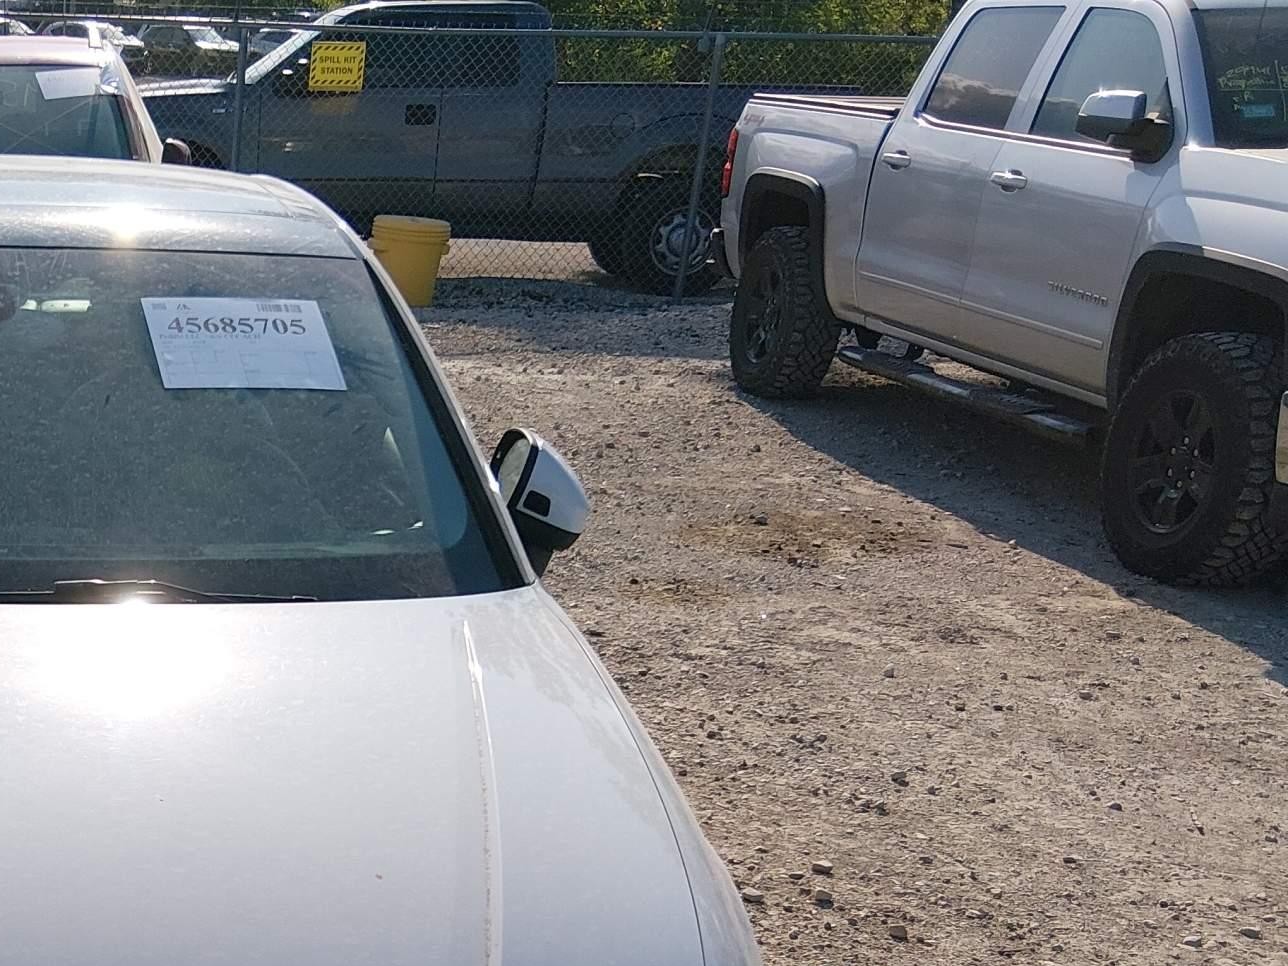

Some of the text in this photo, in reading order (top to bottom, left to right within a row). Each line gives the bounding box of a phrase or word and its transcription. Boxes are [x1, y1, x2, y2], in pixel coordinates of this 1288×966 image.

[319, 56, 357, 64] SPILL KIT
[320, 67, 353, 75] STATION
[167, 317, 307, 335] 45685705
